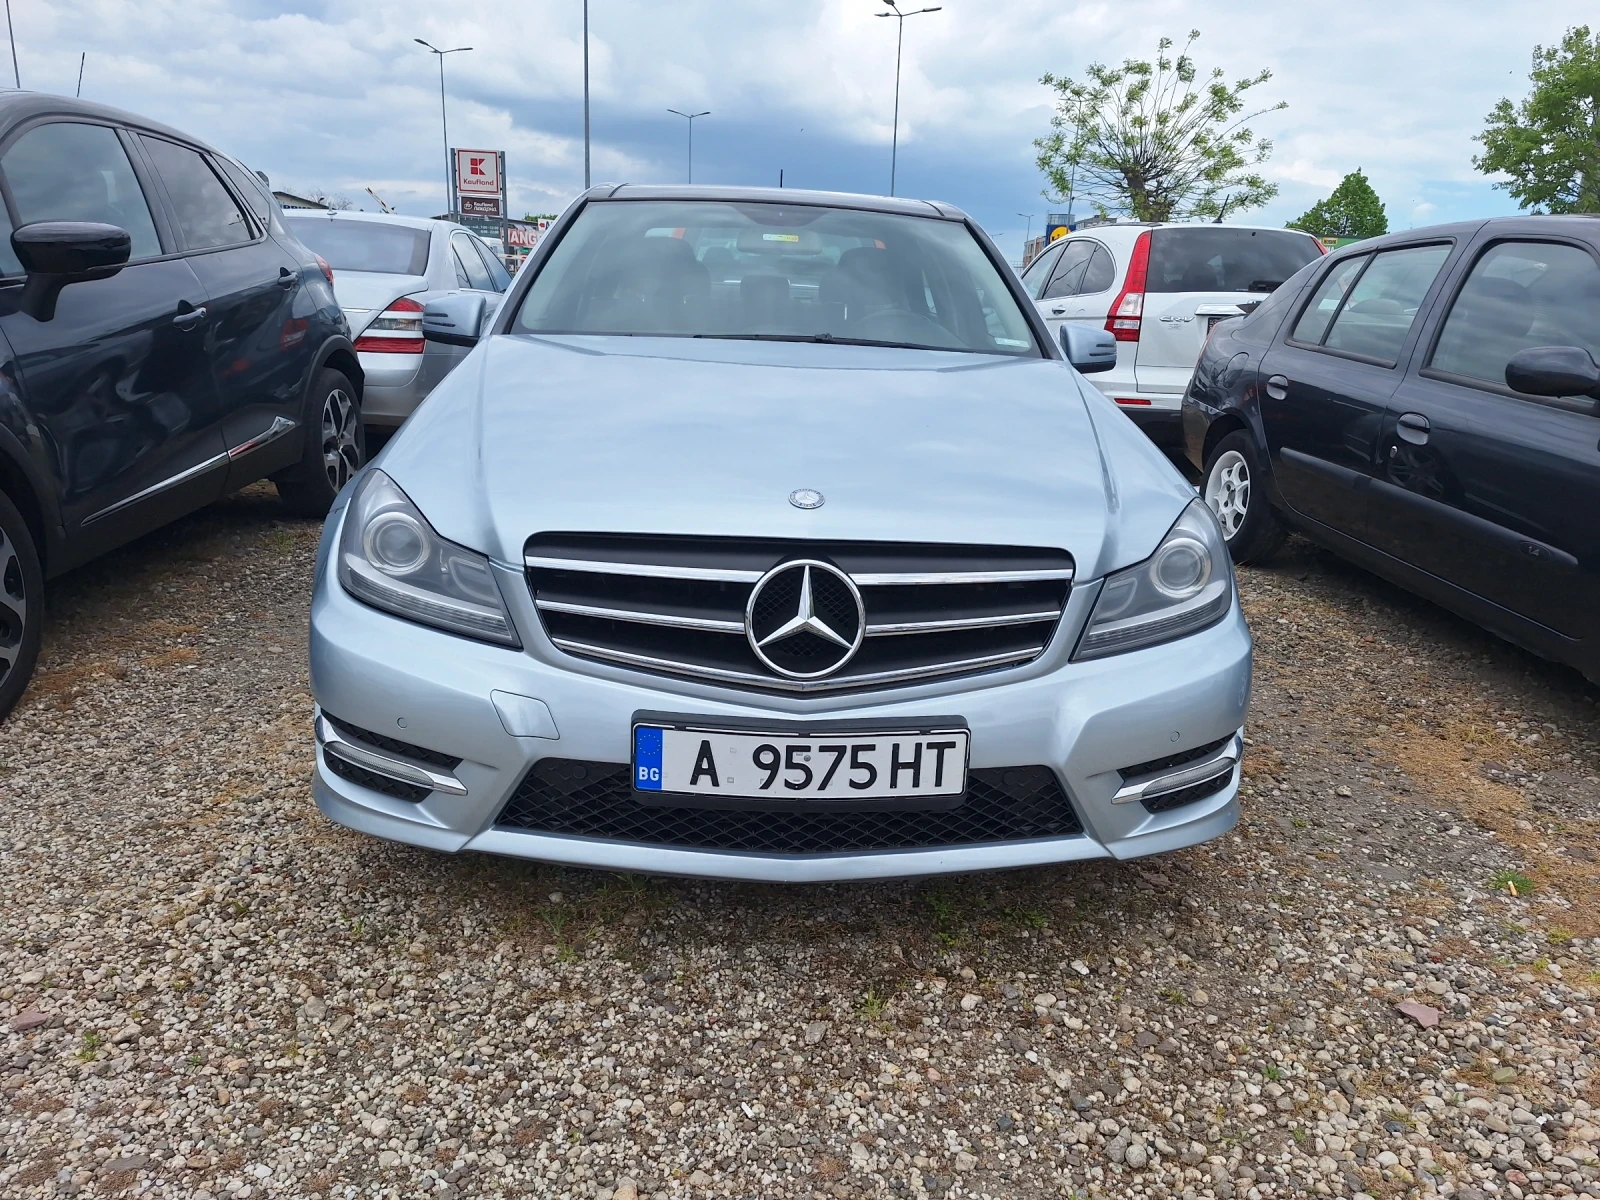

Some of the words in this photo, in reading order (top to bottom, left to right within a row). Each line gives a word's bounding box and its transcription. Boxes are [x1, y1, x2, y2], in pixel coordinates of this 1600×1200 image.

[463, 178, 494, 186] Kaufland
[689, 739, 720, 788] A
[752, 743, 878, 791] 9575
[889, 741, 957, 789] HT
[638, 766, 660, 782] BG
